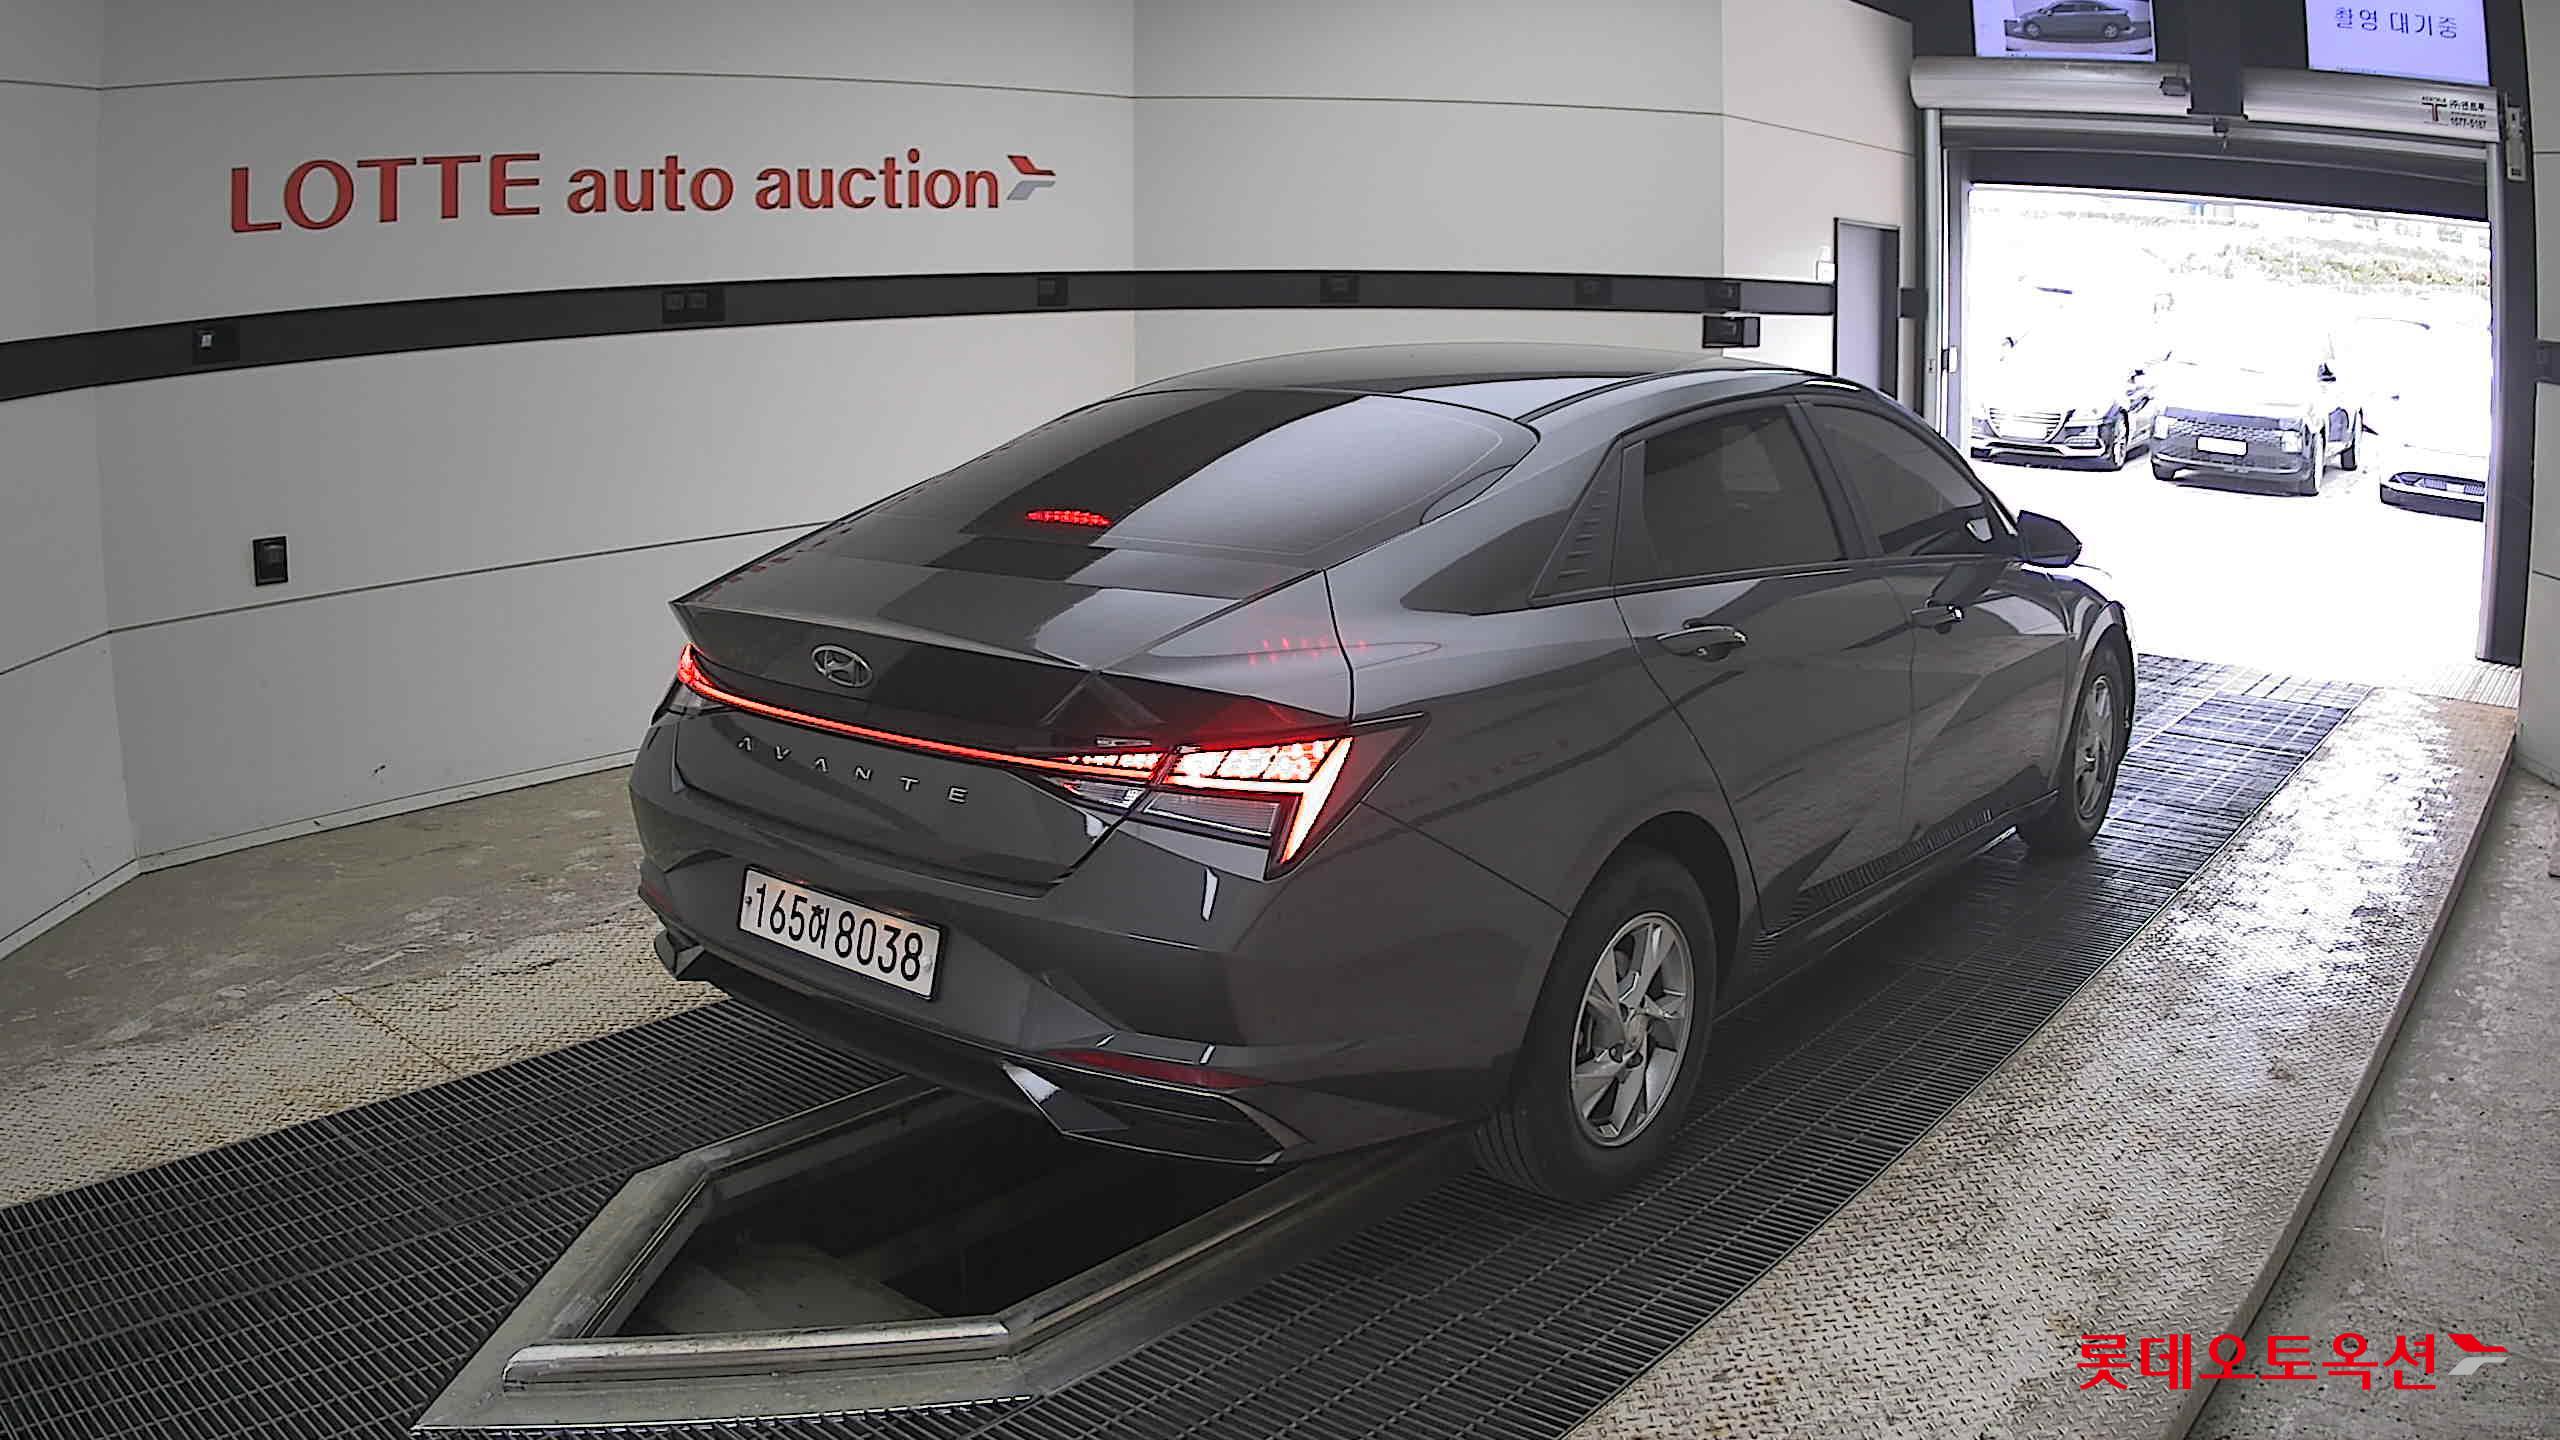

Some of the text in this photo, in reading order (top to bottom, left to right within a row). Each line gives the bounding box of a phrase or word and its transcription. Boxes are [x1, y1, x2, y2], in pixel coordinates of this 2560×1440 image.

[2390, 12, 2457, 39] 대기중
[230, 147, 1001, 234] LOTTE auto auction
[736, 736, 969, 804] AVANTE
